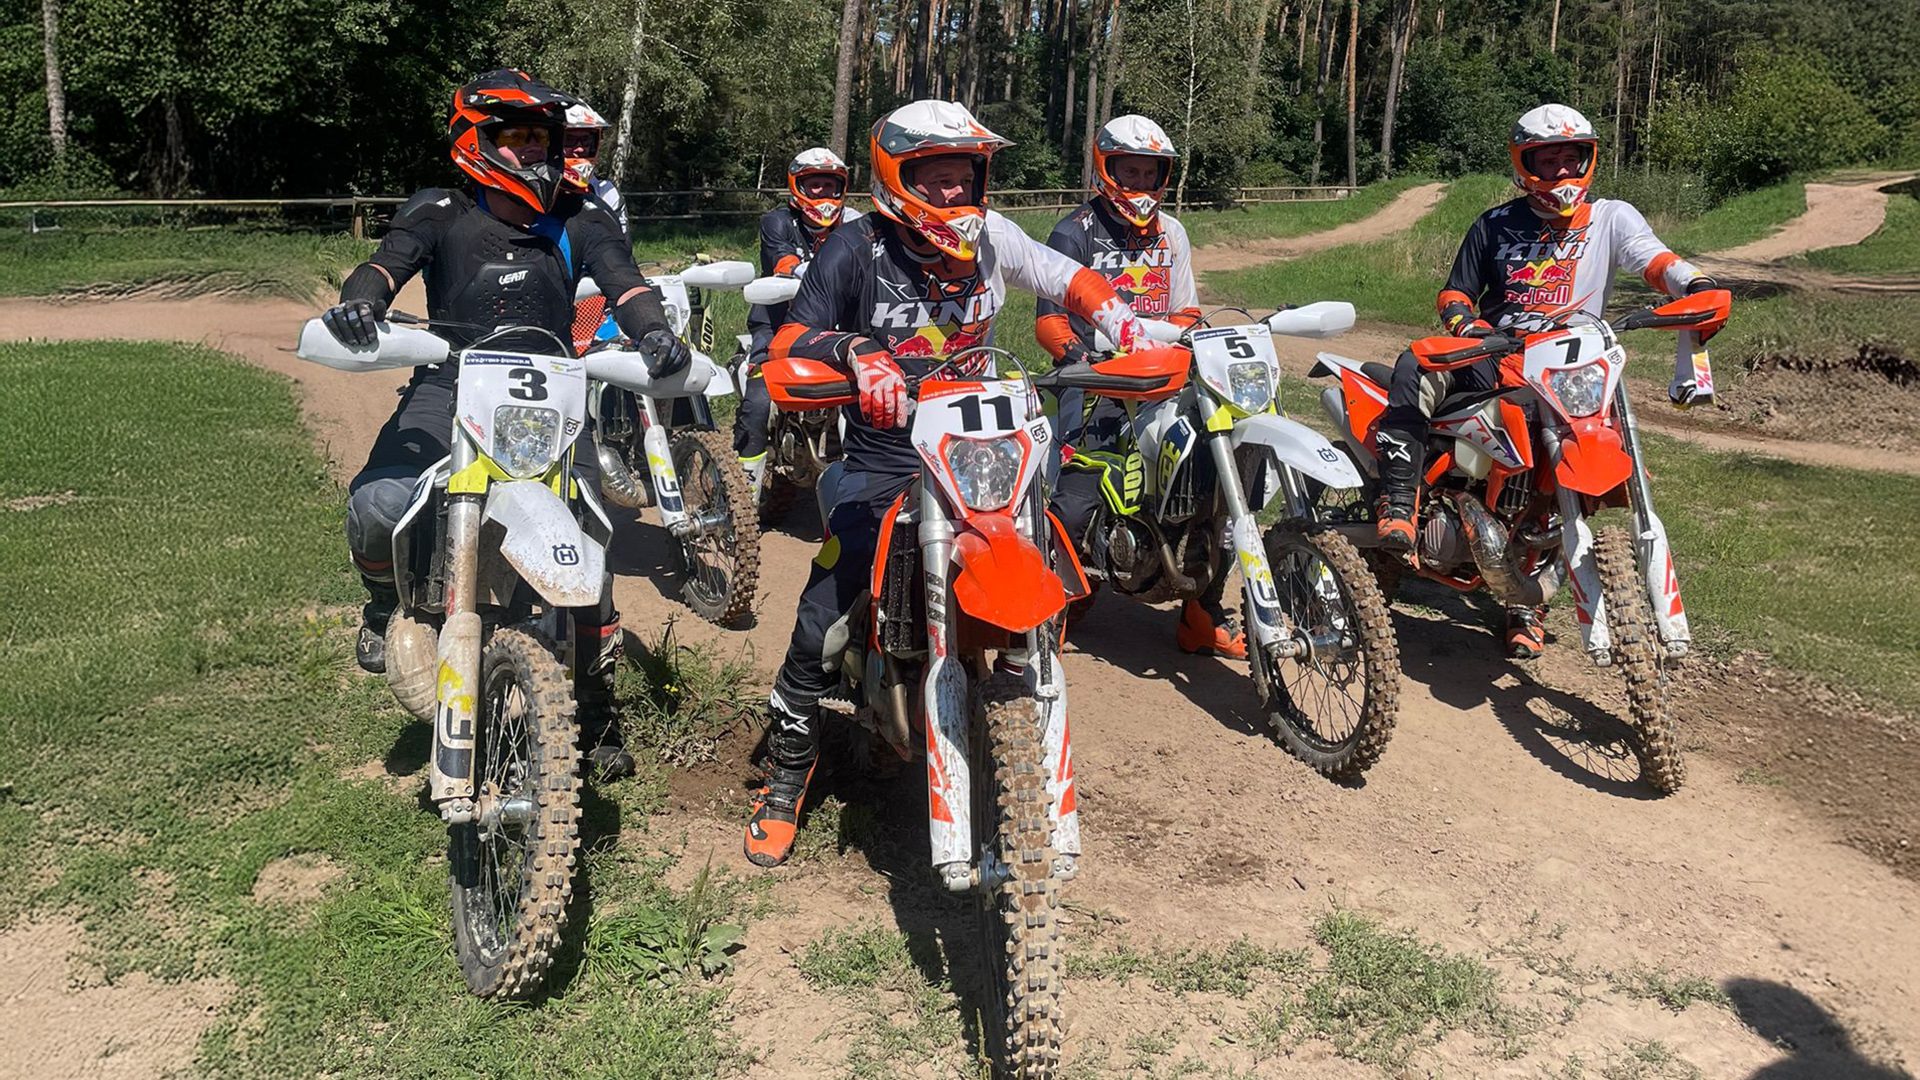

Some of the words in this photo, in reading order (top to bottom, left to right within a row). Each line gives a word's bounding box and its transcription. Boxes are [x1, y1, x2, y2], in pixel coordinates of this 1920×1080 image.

[1090, 248, 1174, 270] KINI
[1494, 238, 1591, 261] KINI
[499, 270, 529, 285] LEATT
[870, 286, 996, 328] KINI
[1141, 293, 1168, 313] Bull
[1224, 336, 1256, 359] 5
[1555, 337, 1581, 365] 7
[508, 367, 548, 401] 3
[947, 394, 1016, 433] 11
[1124, 440, 1143, 503] 100
